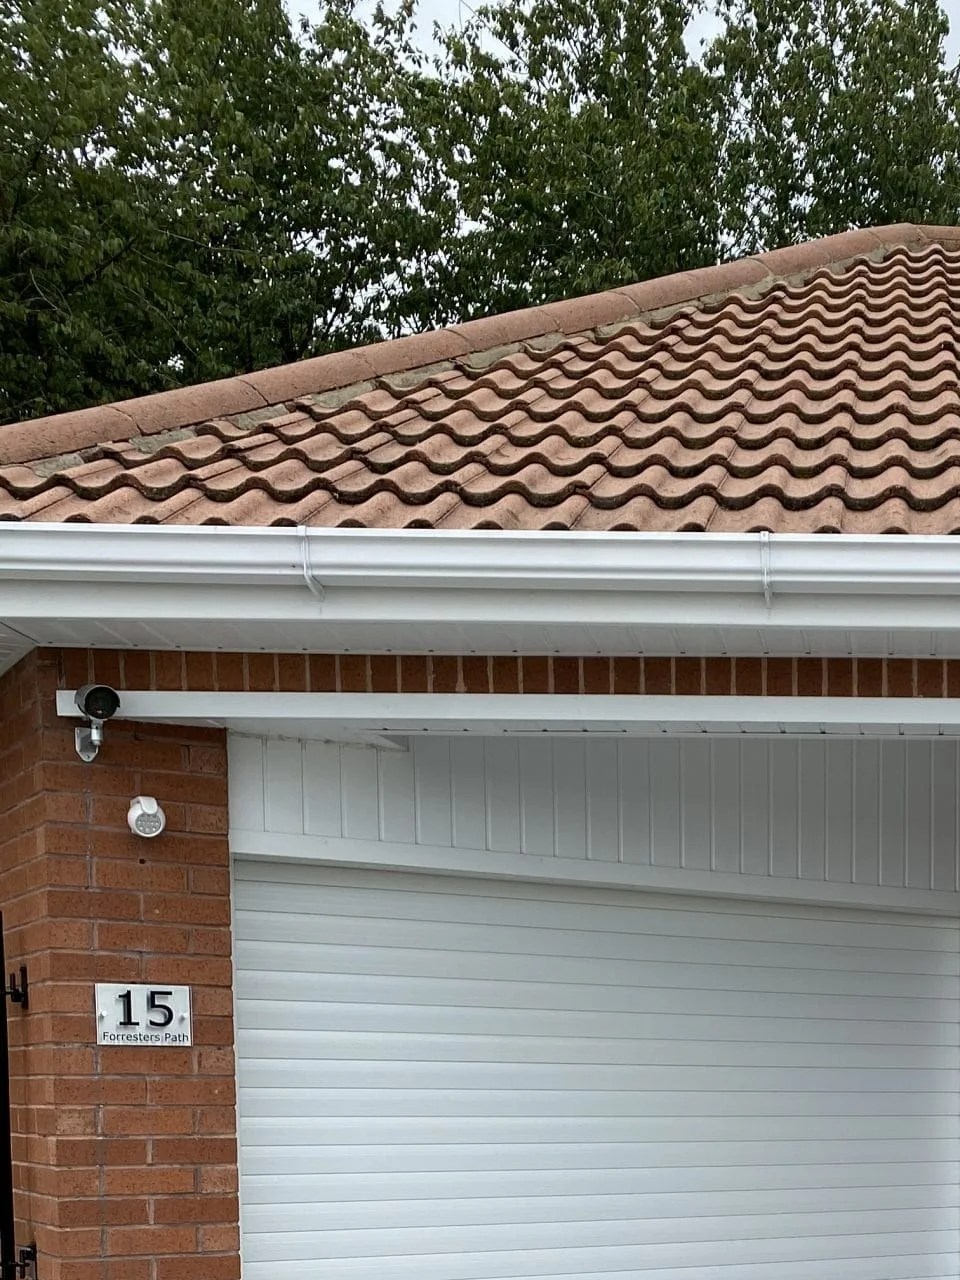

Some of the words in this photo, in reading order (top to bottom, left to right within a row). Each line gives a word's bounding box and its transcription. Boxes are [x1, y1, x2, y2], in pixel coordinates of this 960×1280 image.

[118, 990, 174, 1027] 15
[102, 1031, 161, 1042] Forresters
[164, 1033, 189, 1042] Path
